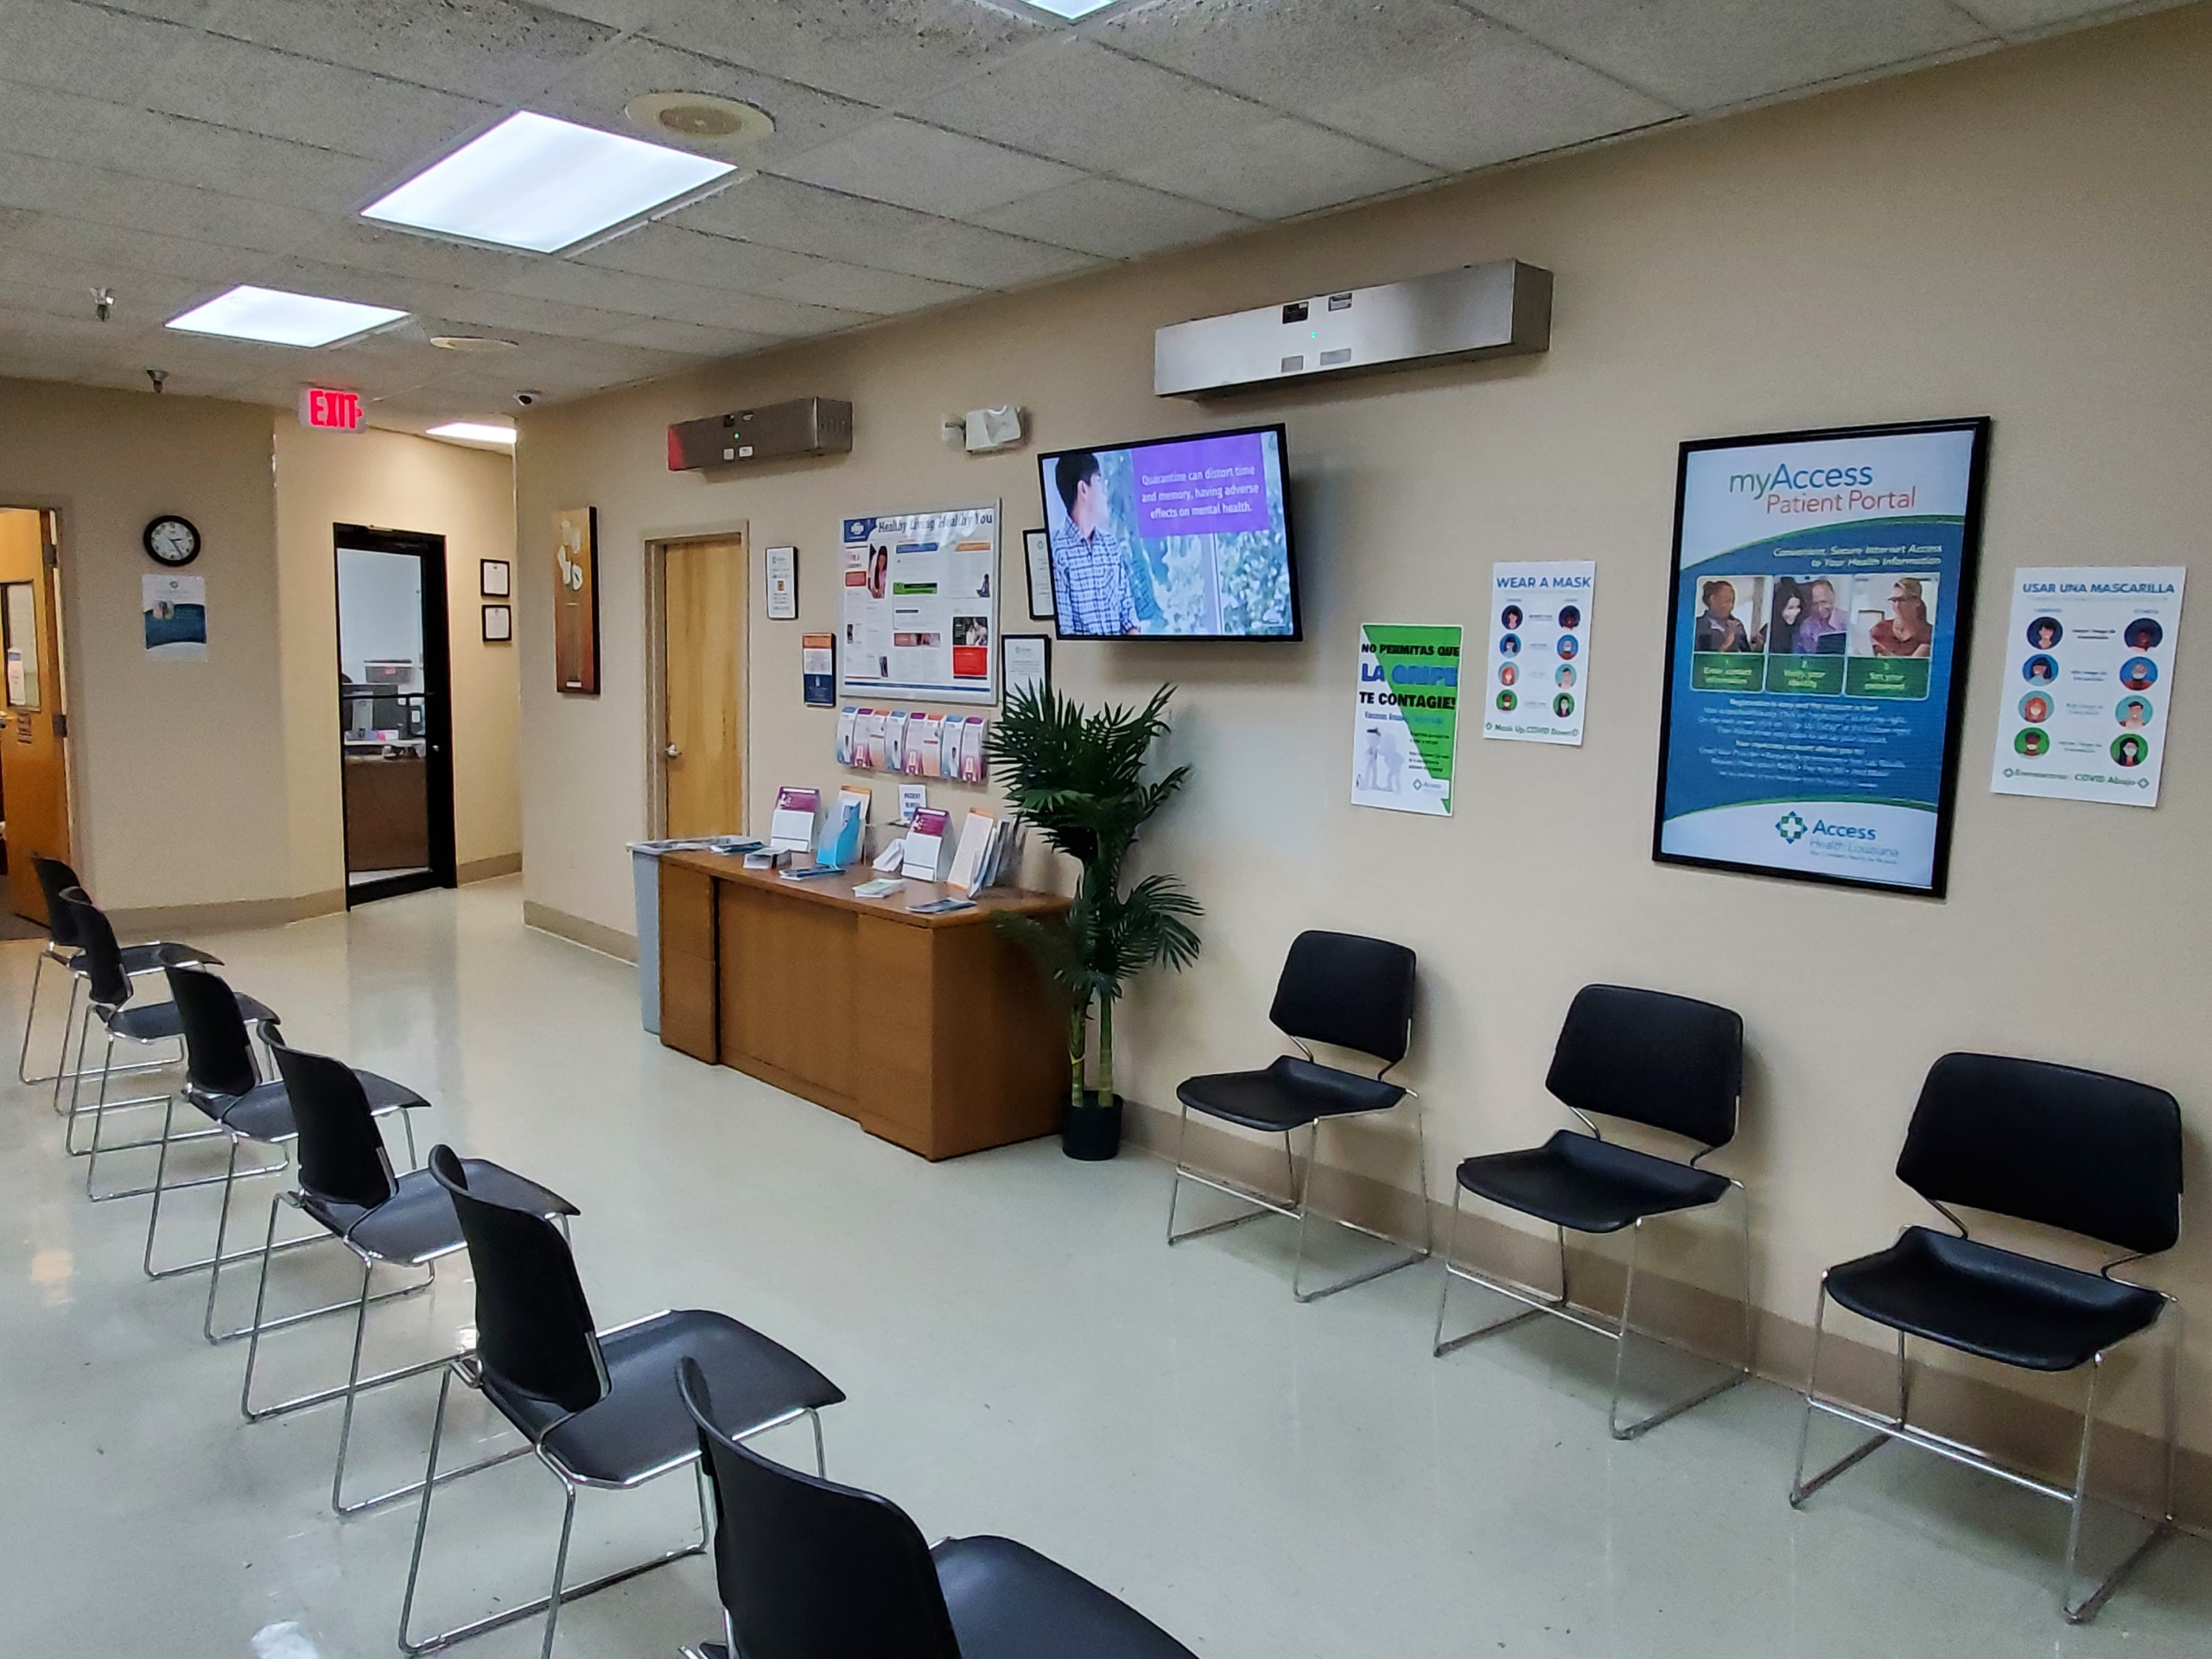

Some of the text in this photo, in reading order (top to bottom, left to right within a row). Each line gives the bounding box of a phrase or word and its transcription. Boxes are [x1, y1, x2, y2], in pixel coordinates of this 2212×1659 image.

[308, 390, 359, 429] EXIT
[1142, 466, 1255, 486] Quarantine can distort time
[1729, 463, 1873, 500] myAccess
[1141, 484, 1259, 502] and memory, having adverse
[1766, 486, 1916, 514] Patient Portal
[1150, 501, 1252, 518] effects on mental health.
[878, 512, 993, 533] Healthy Living Healthy You
[1497, 576, 1592, 588] WEAR A MASK
[2022, 582, 2176, 594] USAR UNA MASCARILLA
[1361, 643, 1460, 657] NO PERMITAS QUE
[1361, 663, 1386, 683] LA
[1359, 691, 1457, 709] TE CONTAGIE!
[2075, 772, 2105, 783] COVID
[1812, 818, 1877, 841] Access
